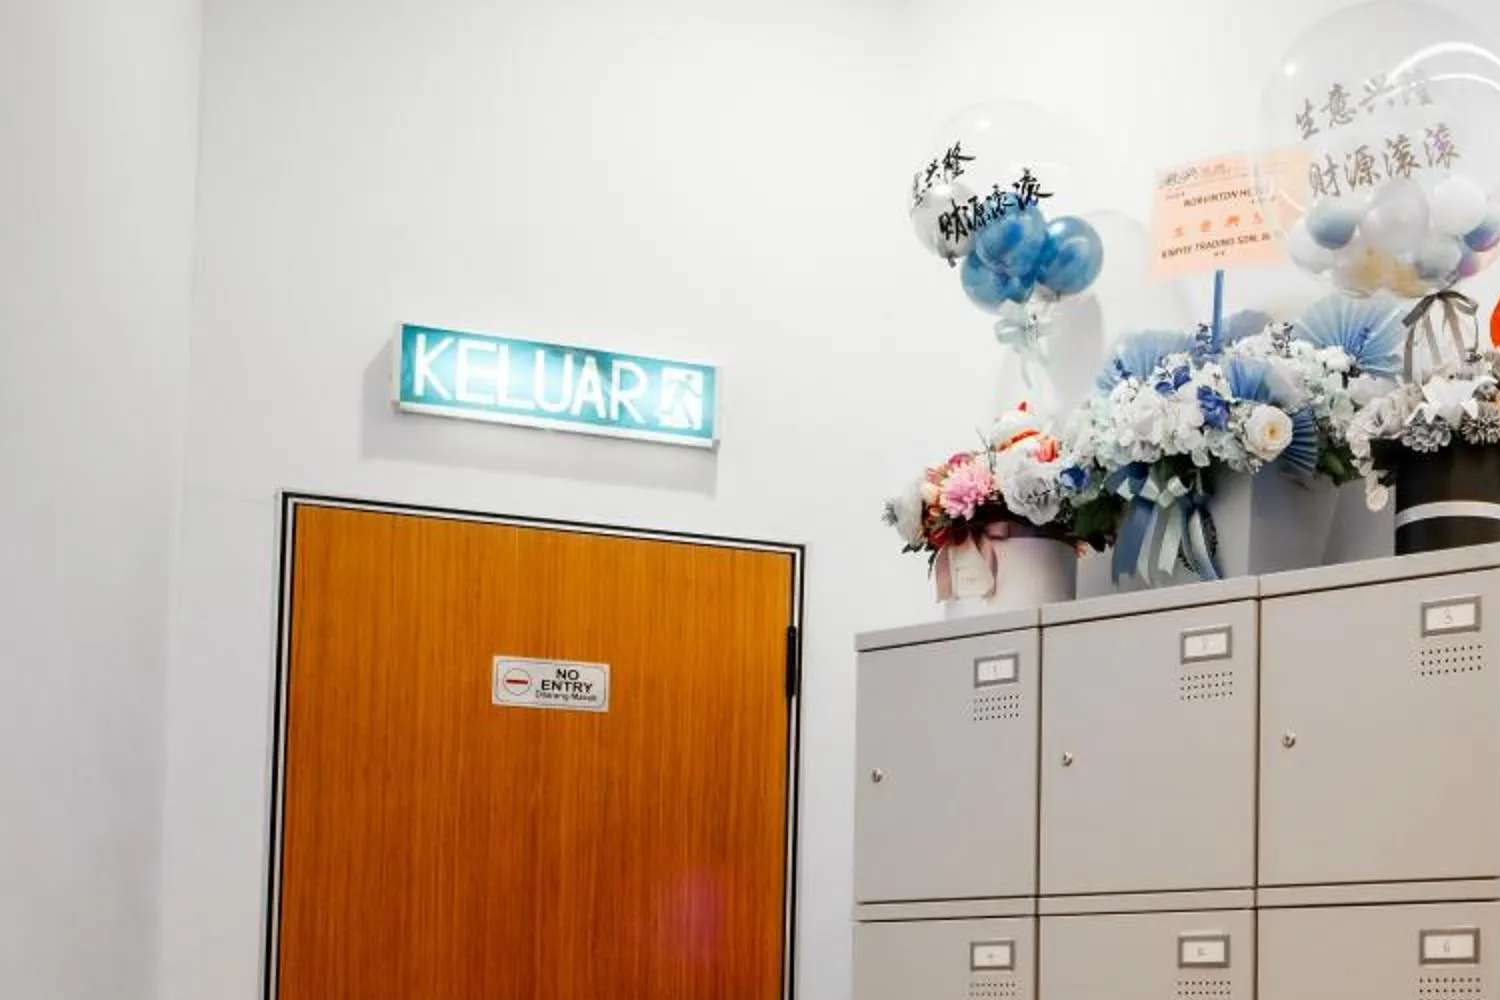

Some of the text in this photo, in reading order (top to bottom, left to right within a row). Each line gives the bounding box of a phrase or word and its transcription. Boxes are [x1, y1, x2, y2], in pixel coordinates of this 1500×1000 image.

[413, 332, 649, 424] KELUAR
[556, 668, 580, 681] NO
[541, 679, 593, 693] ENTRY
